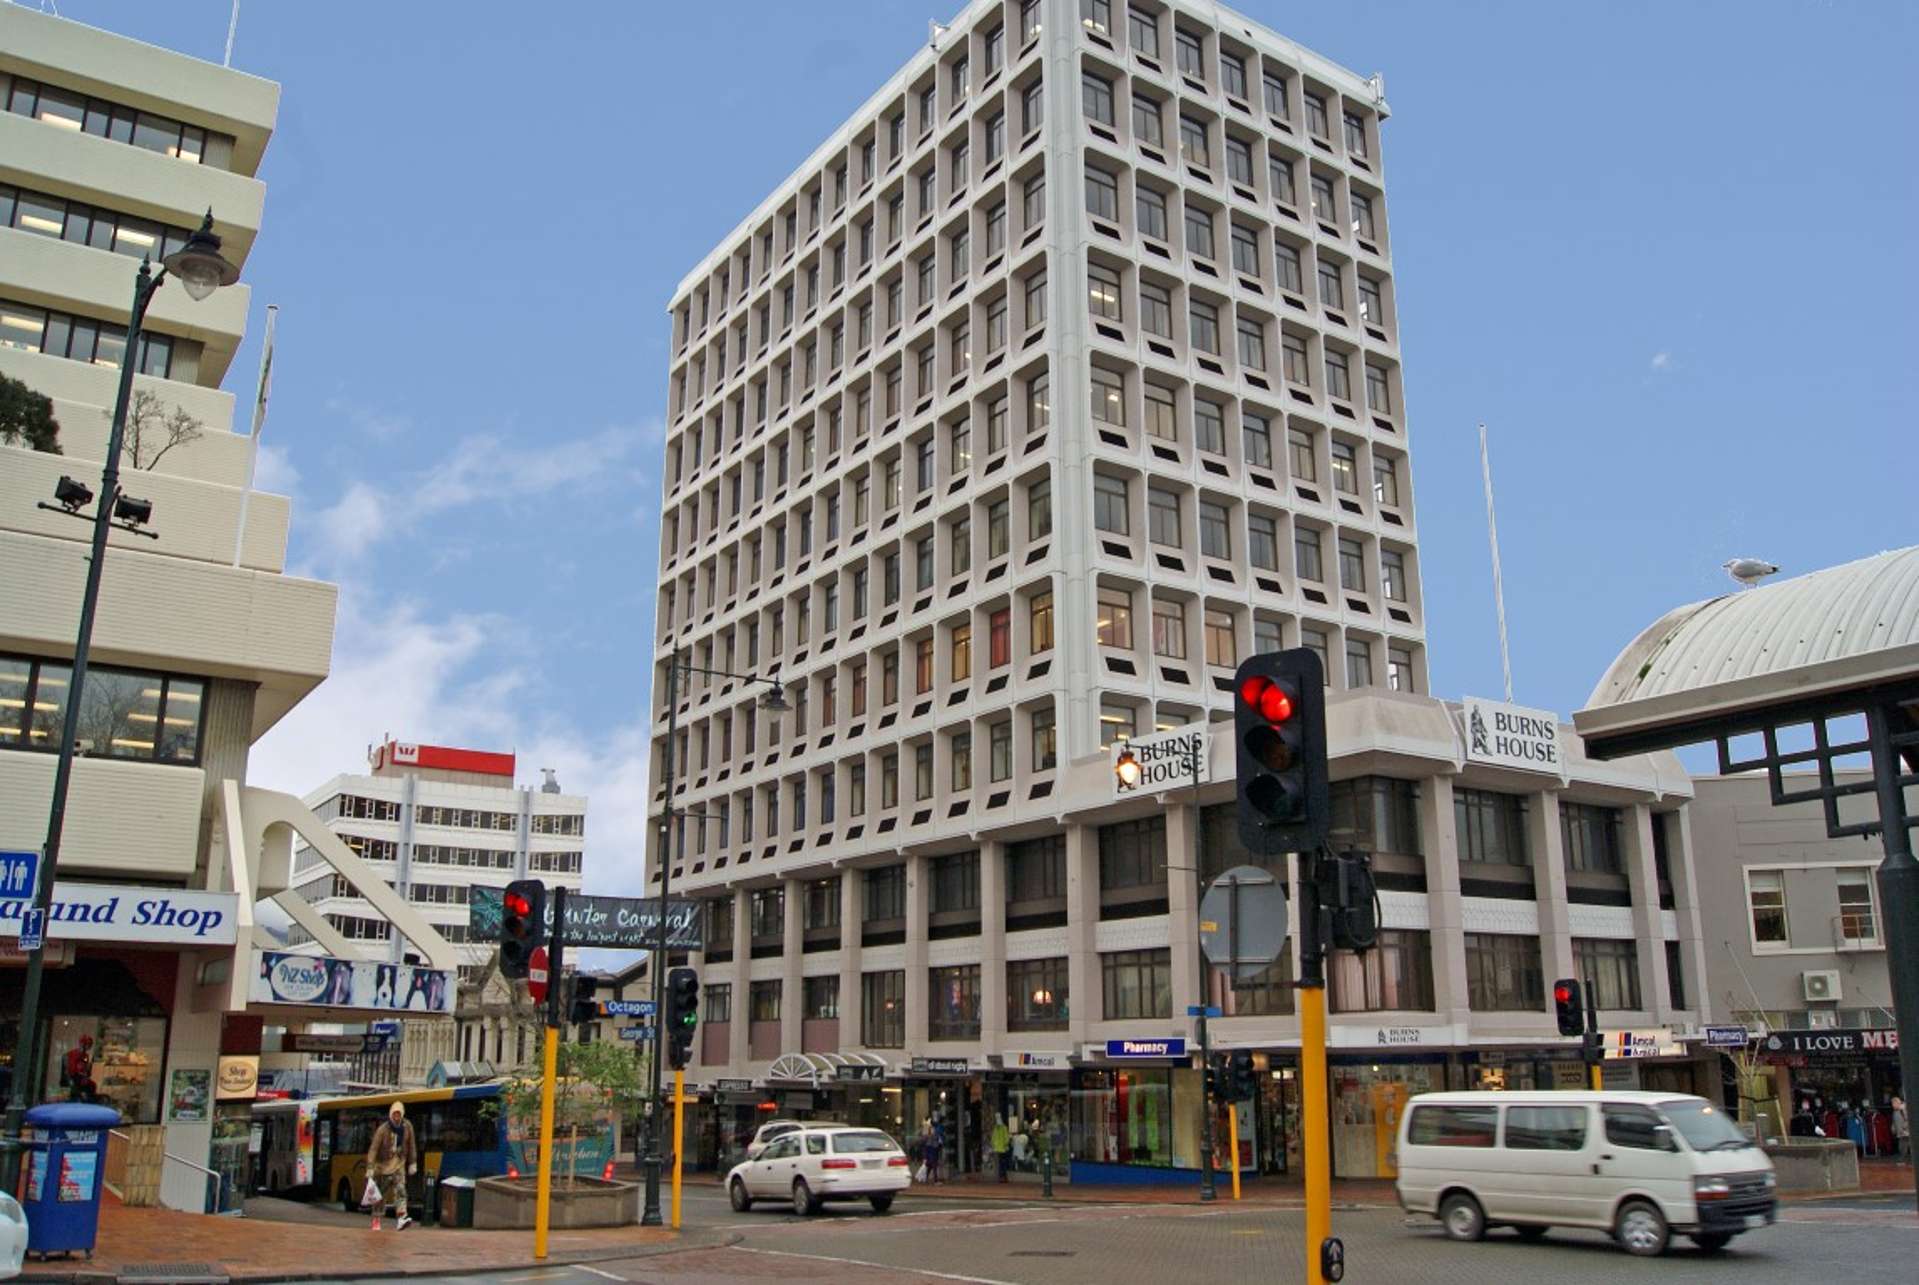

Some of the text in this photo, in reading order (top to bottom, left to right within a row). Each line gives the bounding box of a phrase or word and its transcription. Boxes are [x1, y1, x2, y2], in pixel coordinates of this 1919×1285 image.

[1495, 712, 1555, 741] BURNS
[1140, 732, 1203, 763] BURNS
[1496, 735, 1557, 763] HOUSE
[131, 897, 223, 936] Shop
[607, 1000, 653, 1015] Octagon
[1123, 1041, 1169, 1056] Pharmacy
[1794, 1036, 1801, 1051] I
[1805, 1036, 1855, 1051] LOVE
